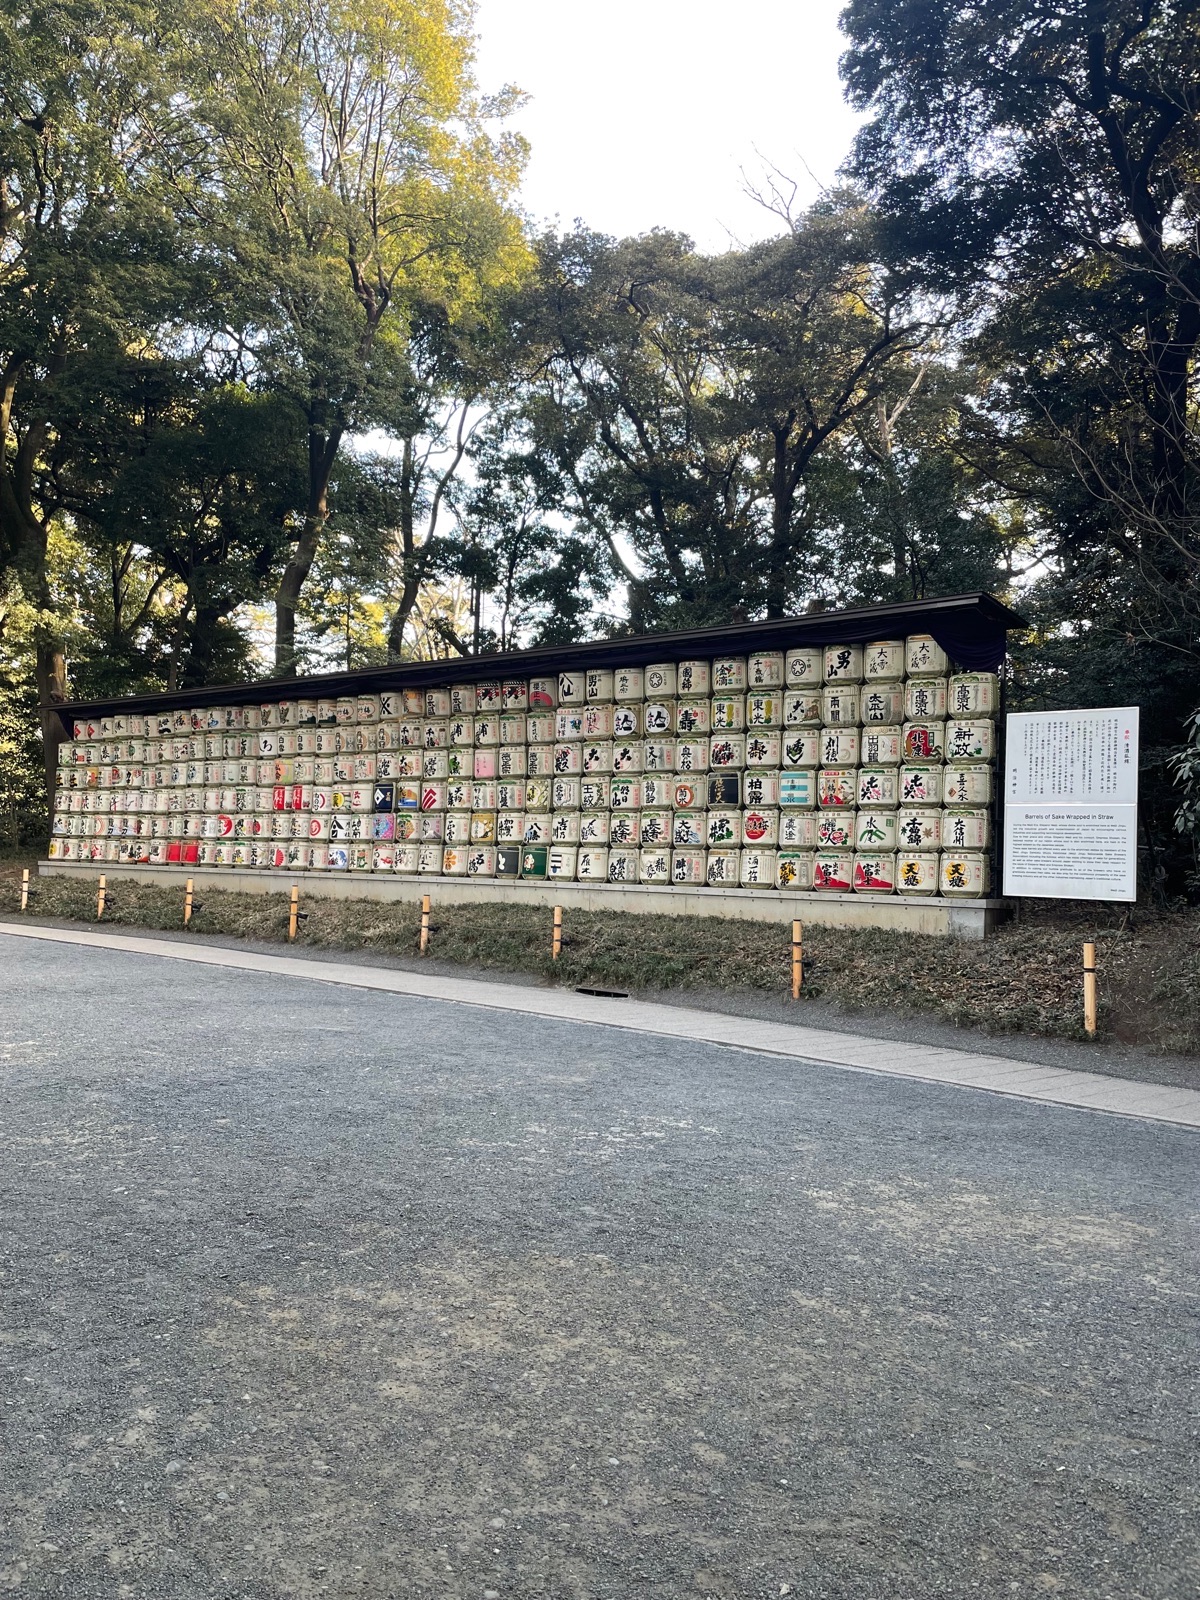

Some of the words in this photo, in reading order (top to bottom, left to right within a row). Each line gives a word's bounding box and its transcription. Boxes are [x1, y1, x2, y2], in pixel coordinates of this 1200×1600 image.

[828, 649, 852, 678] 男山
[877, 648, 888, 670] 大雪
[919, 642, 930, 665] 大雪
[560, 673, 573, 701] 八仙
[588, 675, 598, 697] 男山
[716, 703, 725, 728] 東光
[753, 699, 764, 725] 東光
[787, 700, 804, 721] 大山
[868, 693, 884, 720] 太平山
[954, 727, 975, 757] 新政
[584, 748, 600, 770] 大七
[614, 748, 632, 770] 大七
[681, 746, 692, 770] 奥の松
[583, 785, 594, 807] 王紋
[678, 789, 688, 804] 菊水
[957, 773, 969, 801] 喜久水
[865, 816, 877, 844] 水尾
[953, 818, 965, 847] 大信州
[581, 854, 591, 874] 雁木
